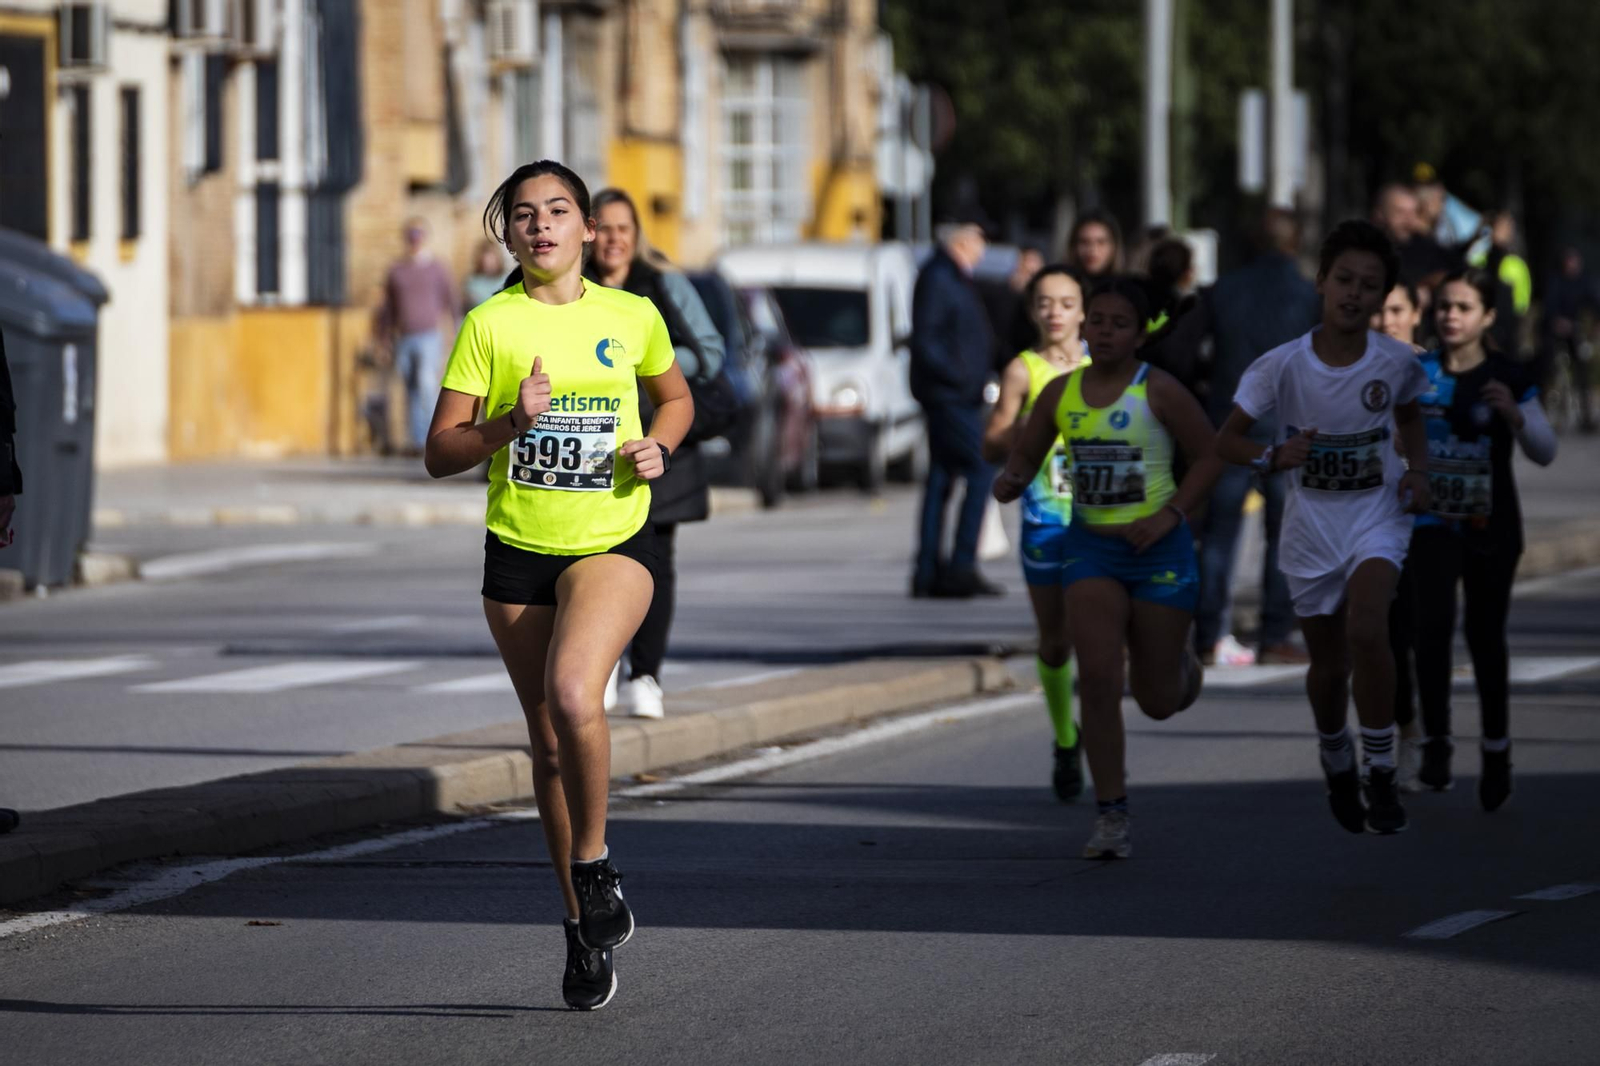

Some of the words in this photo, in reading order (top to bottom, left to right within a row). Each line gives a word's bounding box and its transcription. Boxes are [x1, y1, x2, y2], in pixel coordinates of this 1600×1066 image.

[550, 392, 621, 412] etismo
[534, 423, 570, 432] OMBEROS
[536, 415, 549, 423] ERA
[550, 417, 581, 425] INFANTIL
[582, 416, 614, 425] BENÉFICA
[517, 433, 582, 471] 593
[1306, 449, 1358, 477] 585
[1077, 465, 1114, 491] 577
